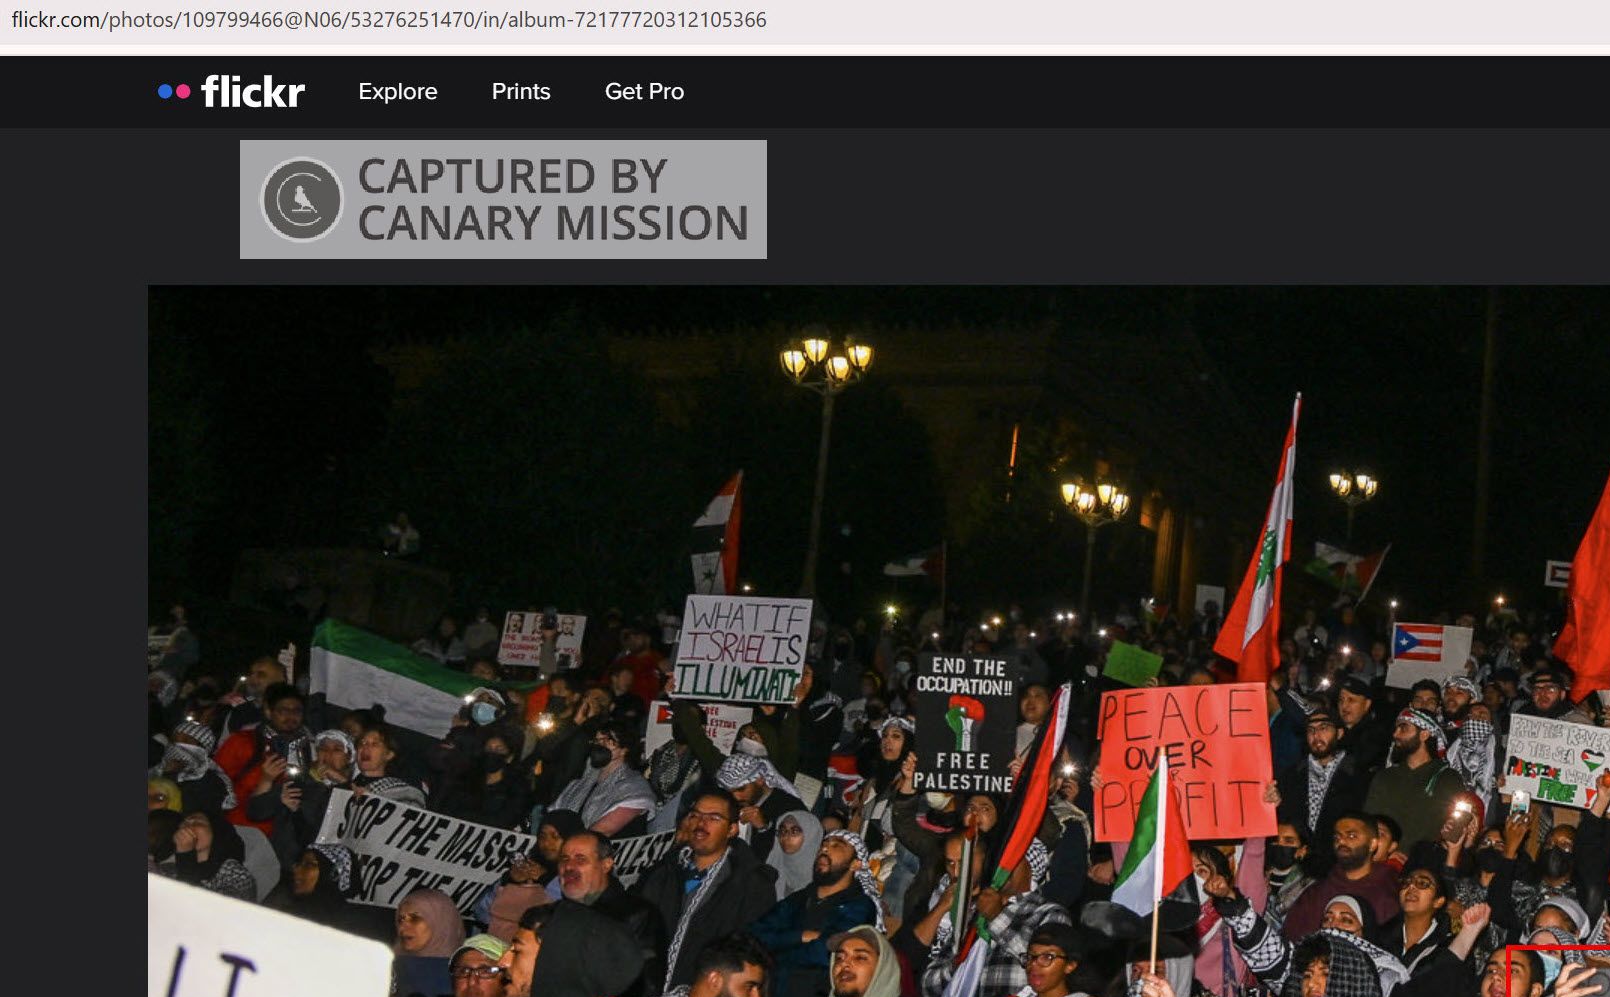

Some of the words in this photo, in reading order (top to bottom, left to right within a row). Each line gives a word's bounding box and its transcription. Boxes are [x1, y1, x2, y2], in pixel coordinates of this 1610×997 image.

[12, 10, 767, 33] flickr.com/photos/109799466@N06/53276251470/in/album-72177720312105366
[201, 74, 306, 108] flickr
[359, 82, 438, 104] Explore
[492, 82, 552, 101] Prints
[604, 82, 644, 101] Get
[650, 82, 685, 101] Pro
[691, 600, 769, 631] WHAT
[679, 630, 768, 664] ISRAEL
[766, 634, 802, 665] IS
[932, 656, 965, 674] END
[973, 659, 1007, 677] THE
[916, 676, 1013, 696] OCCUPATION!!
[1100, 689, 1263, 744] PEACE
[937, 752, 990, 770] FREE
[914, 772, 1013, 793] PALESTINE
[336, 795, 397, 839] STOP
[385, 808, 450, 857] THE
